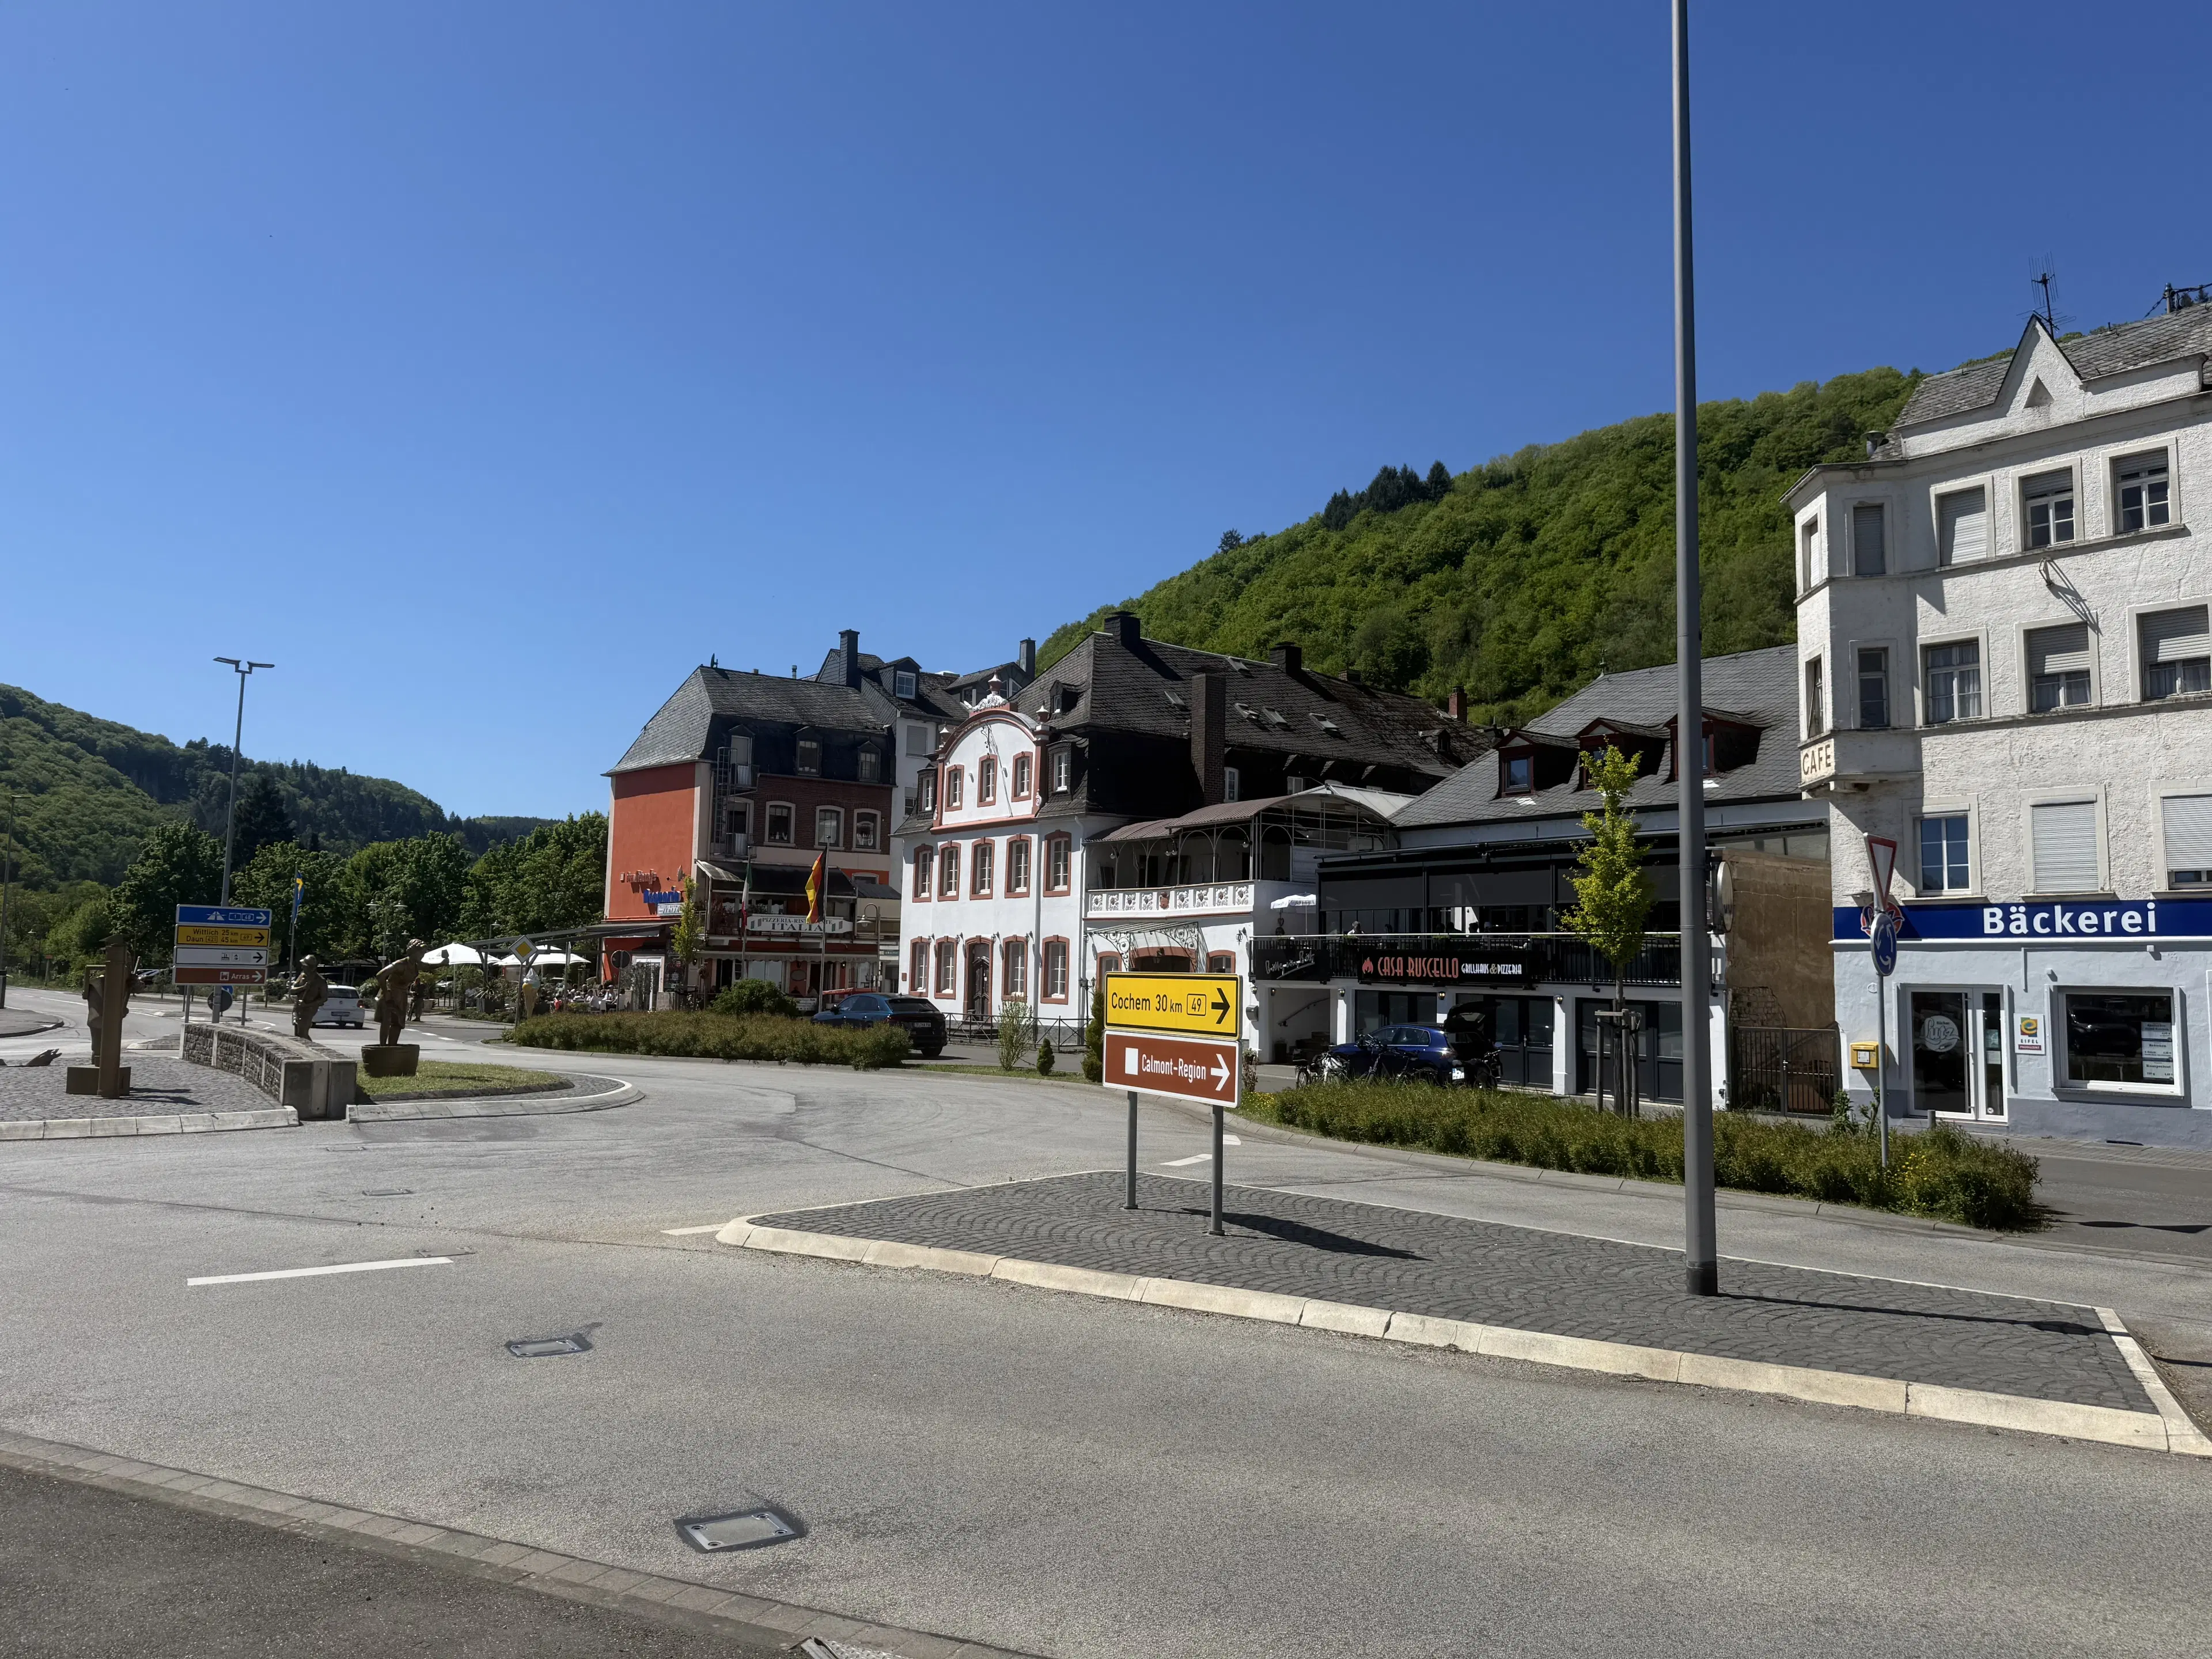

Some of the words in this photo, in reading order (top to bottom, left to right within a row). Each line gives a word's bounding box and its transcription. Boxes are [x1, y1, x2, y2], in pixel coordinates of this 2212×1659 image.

[1802, 744, 1831, 775] CAFE
[771, 922, 823, 931] ITALIA
[1983, 902, 2156, 934] Bäckerei
[1377, 956, 1403, 976] CASA
[1406, 956, 1459, 978] RUSCELLO
[1461, 963, 1489, 974] GRILLHAUS
[1489, 963, 1497, 975] &
[1497, 964, 1522, 975] PIZZERIA
[1111, 991, 1150, 1011] Cochem
[1155, 994, 1168, 1012] 30
[1170, 999, 1182, 1013] km
[1191, 998, 1202, 1012] 49
[1141, 1054, 1206, 1083] Calmont-Region
